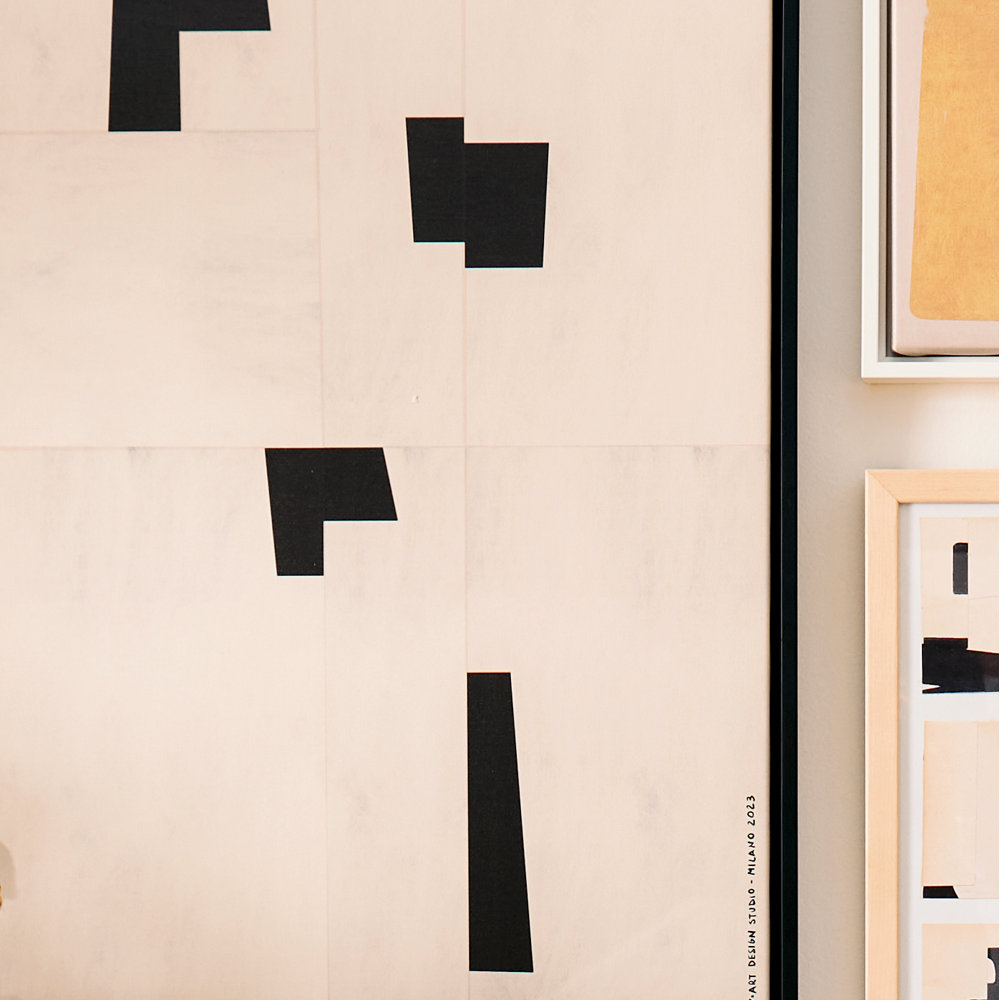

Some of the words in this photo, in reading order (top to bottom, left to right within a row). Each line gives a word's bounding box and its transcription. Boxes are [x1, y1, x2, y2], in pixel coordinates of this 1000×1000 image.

[746, 795, 756, 826] 2023
[747, 832, 756, 876] MILANO
[747, 888, 756, 925] STUDIO
[747, 930, 756, 967] DESIGN
